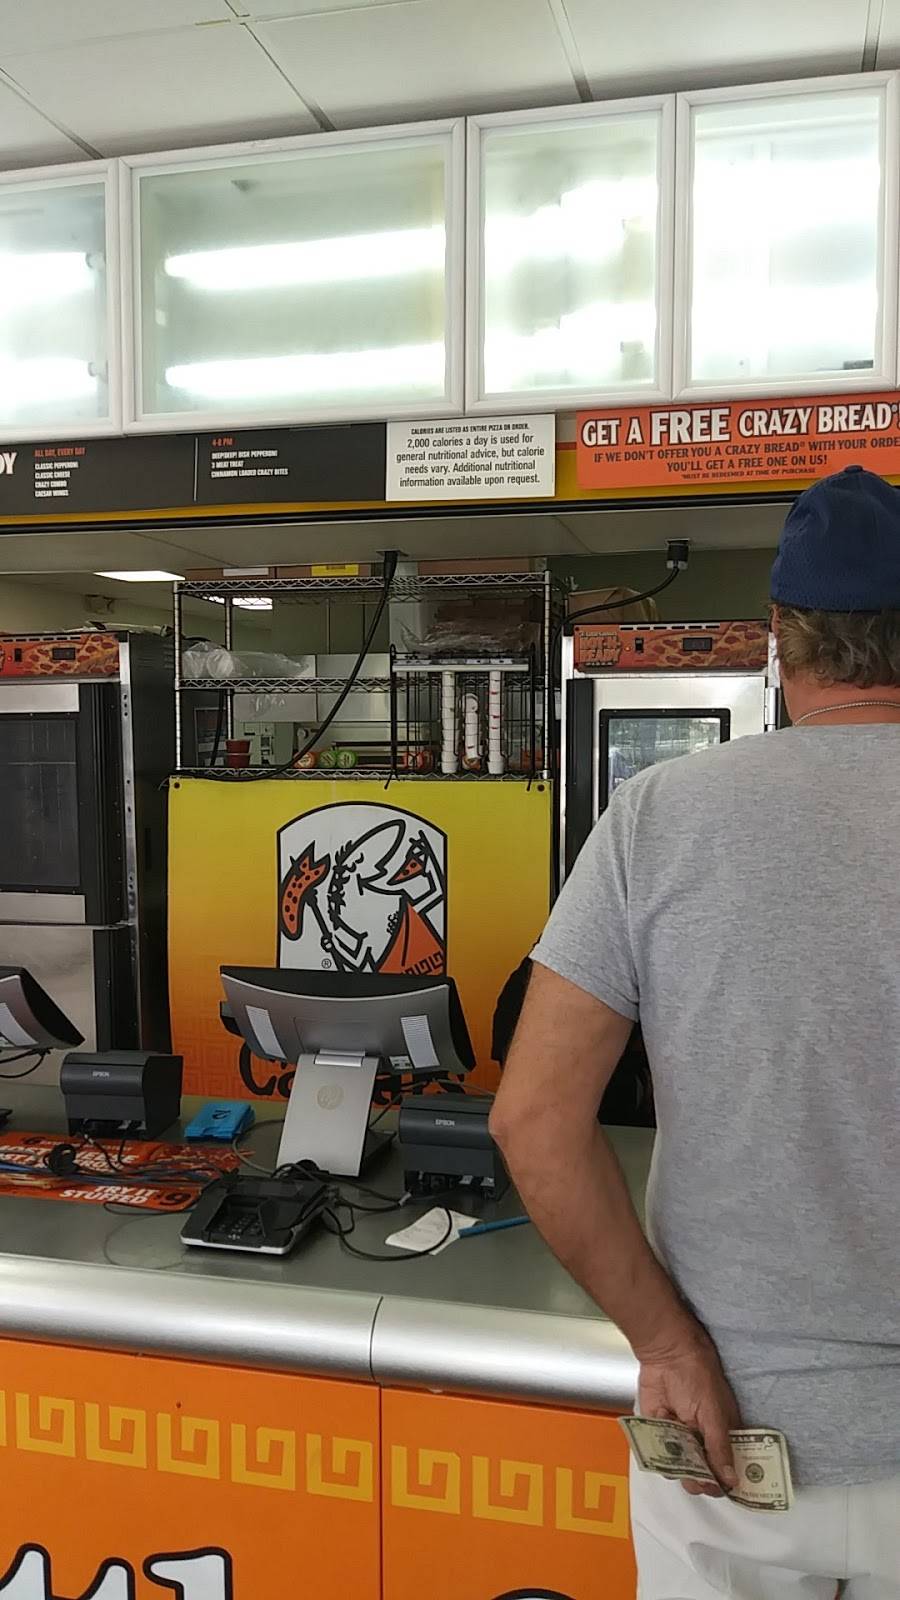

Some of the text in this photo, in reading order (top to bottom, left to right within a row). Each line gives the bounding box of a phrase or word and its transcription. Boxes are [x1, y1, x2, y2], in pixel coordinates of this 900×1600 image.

[582, 418, 621, 447] GET
[626, 417, 644, 445] A
[650, 407, 731, 446] FREE
[738, 406, 813, 438] CRAZY
[223, 437, 233, 446] PM
[407, 433, 534, 449] 2,000 calories a day is used for
[35, 449, 44, 457] ALL
[57, 448, 73, 456] EVERY
[251, 450, 278, 458] PEPPERONI
[396, 446, 544, 463] general nutritional advice, but calorie
[594, 453, 602, 463] IF
[606, 452, 621, 463] WE
[624, 450, 655, 462] DON'T
[658, 448, 688, 460] OFFER
[691, 447, 711, 458] YOU
[714, 447, 722, 456] A
[725, 443, 761, 455] CRAZY
[808, 440, 838, 452] WITH
[839, 438, 867, 450] YOUR
[54, 461, 79, 469] PEPPERONI
[229, 460, 244, 468] TREAT
[405, 459, 536, 475] needs vary. Additional nutritional
[667, 454, 827, 472] YOU'LL GET A FREE ONE ON US!
[211, 468, 288, 478] CINNAMON LOADED CRAZY BITES
[781, 467, 816, 475] PURCHASE
[400, 473, 540, 487] information available upon request.
[59, 1189, 148, 1204] STUFFED
[94, 1185, 160, 1197] TRY IT
